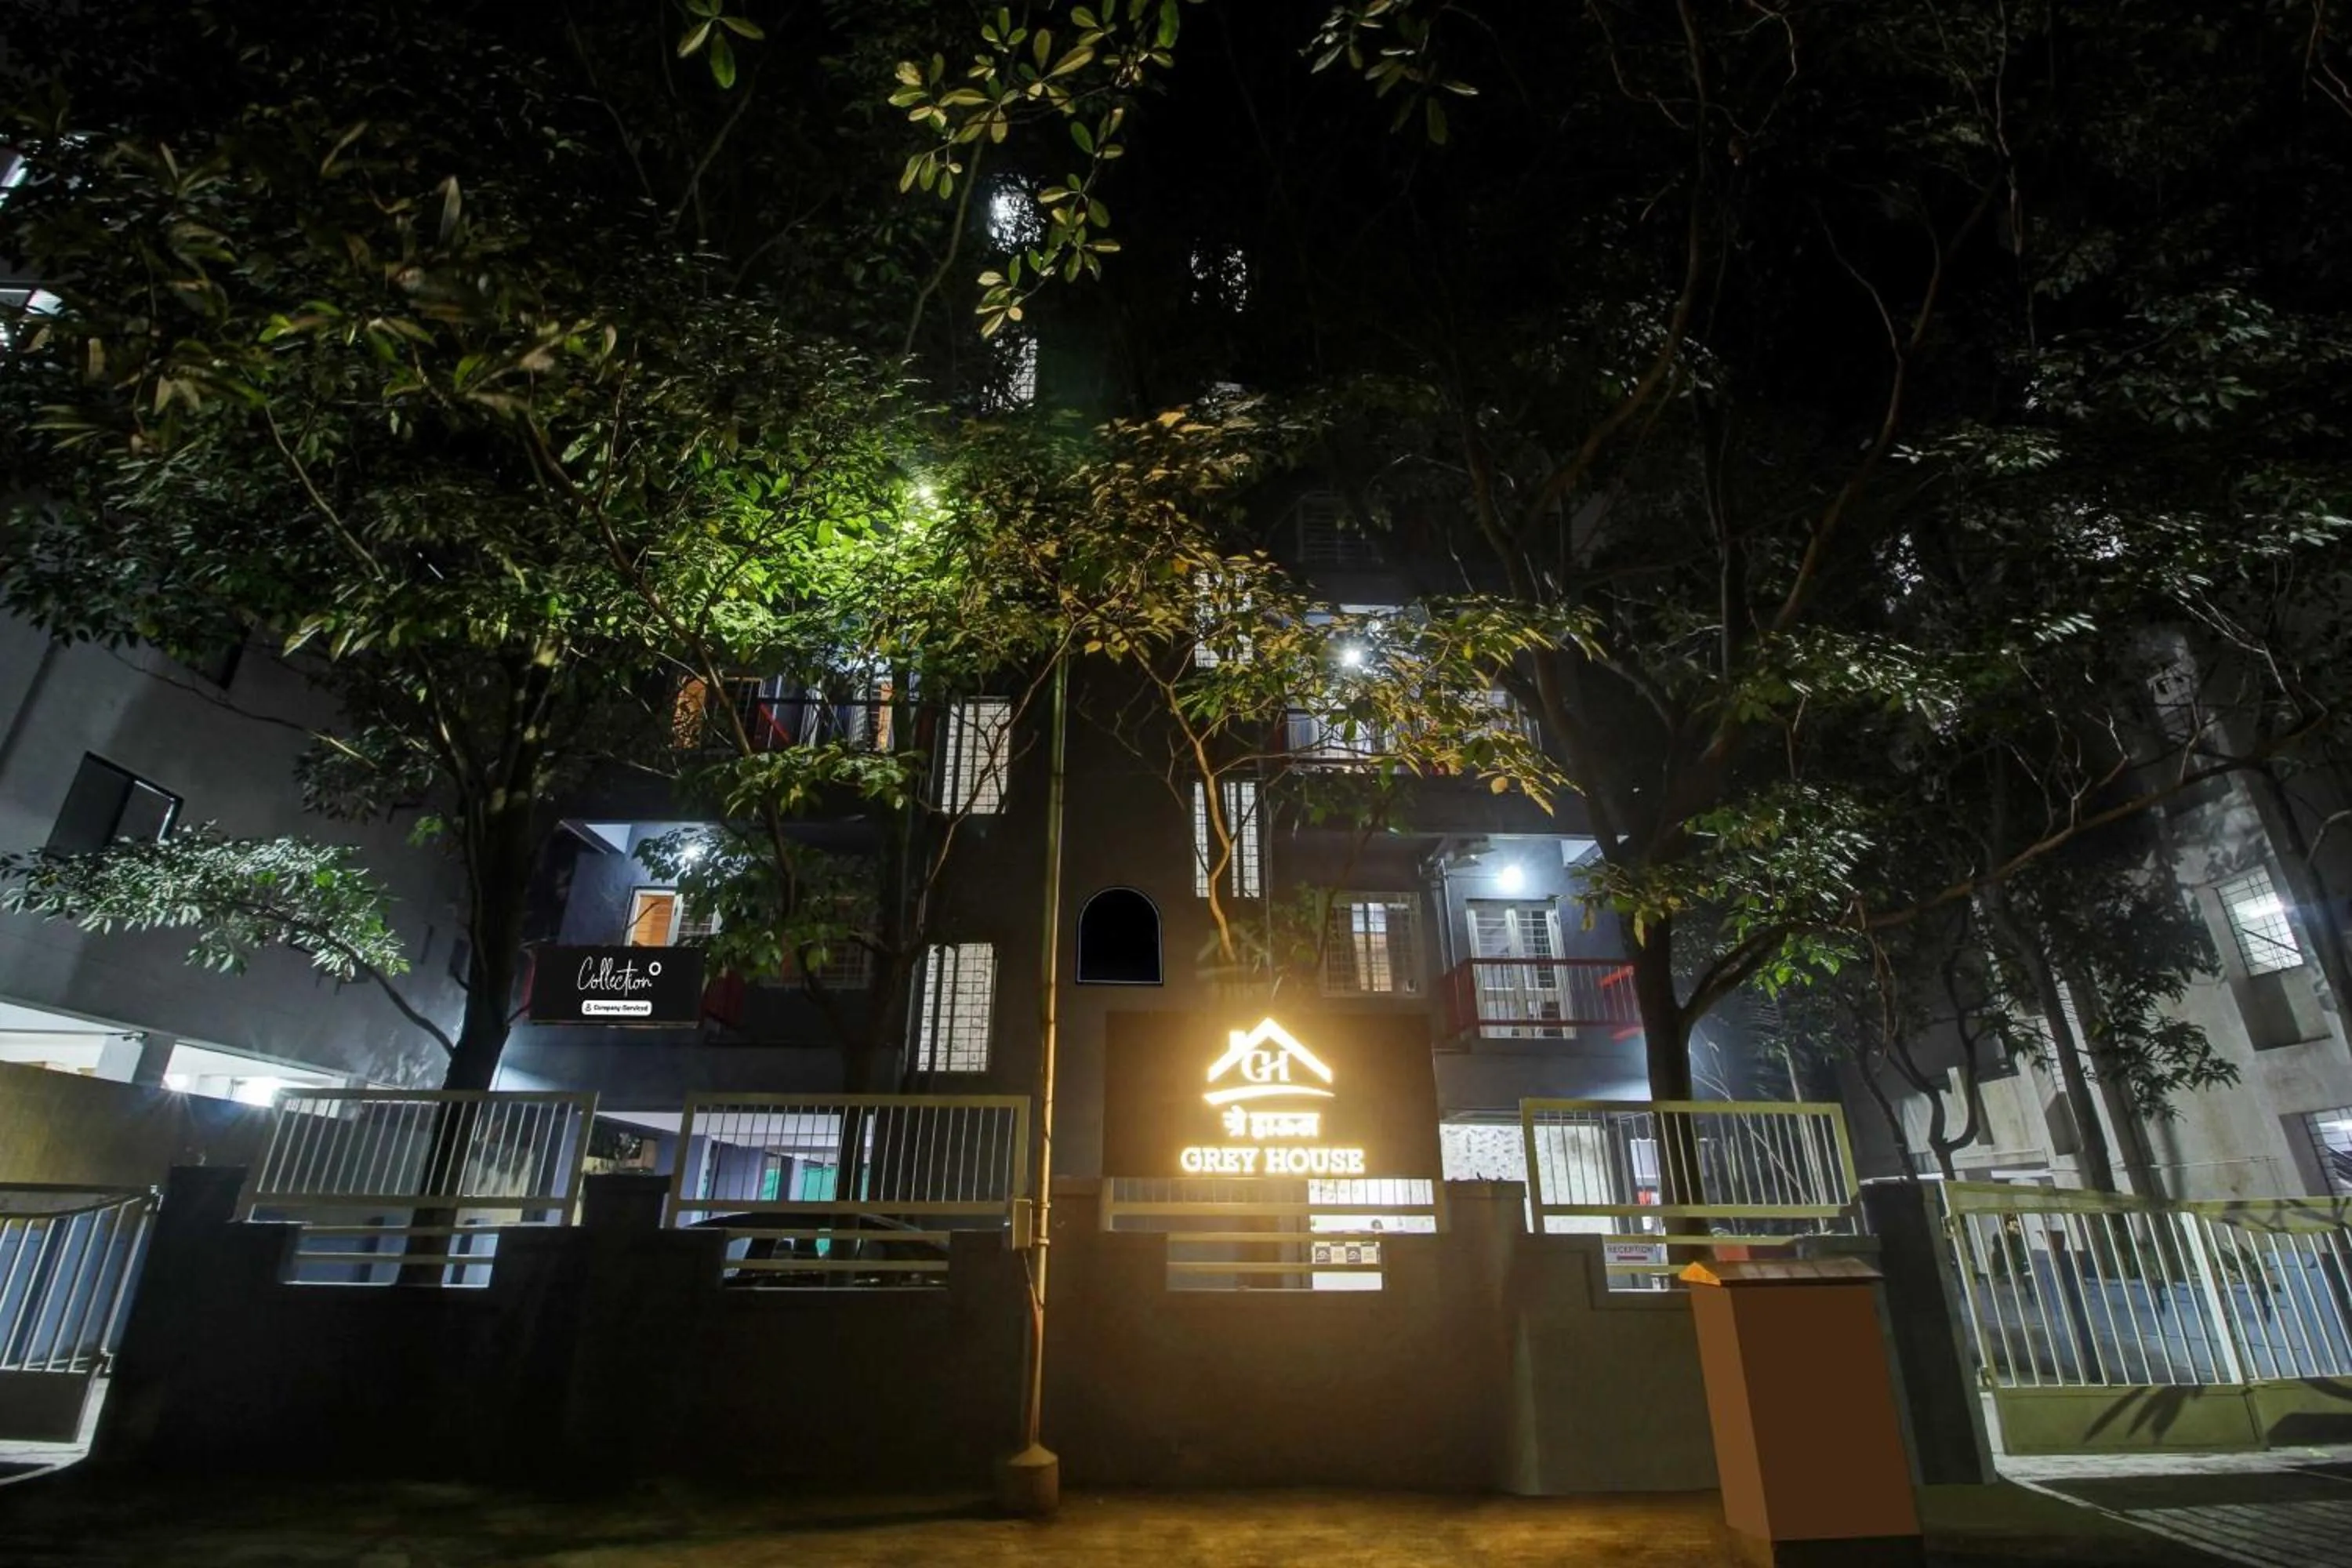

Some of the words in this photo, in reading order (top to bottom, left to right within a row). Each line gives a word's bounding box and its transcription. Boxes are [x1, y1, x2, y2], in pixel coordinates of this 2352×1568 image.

[577, 956, 652, 998] Collection
[1180, 1147, 1259, 1173] GREY
[1264, 1147, 1366, 1174] HOUSE
